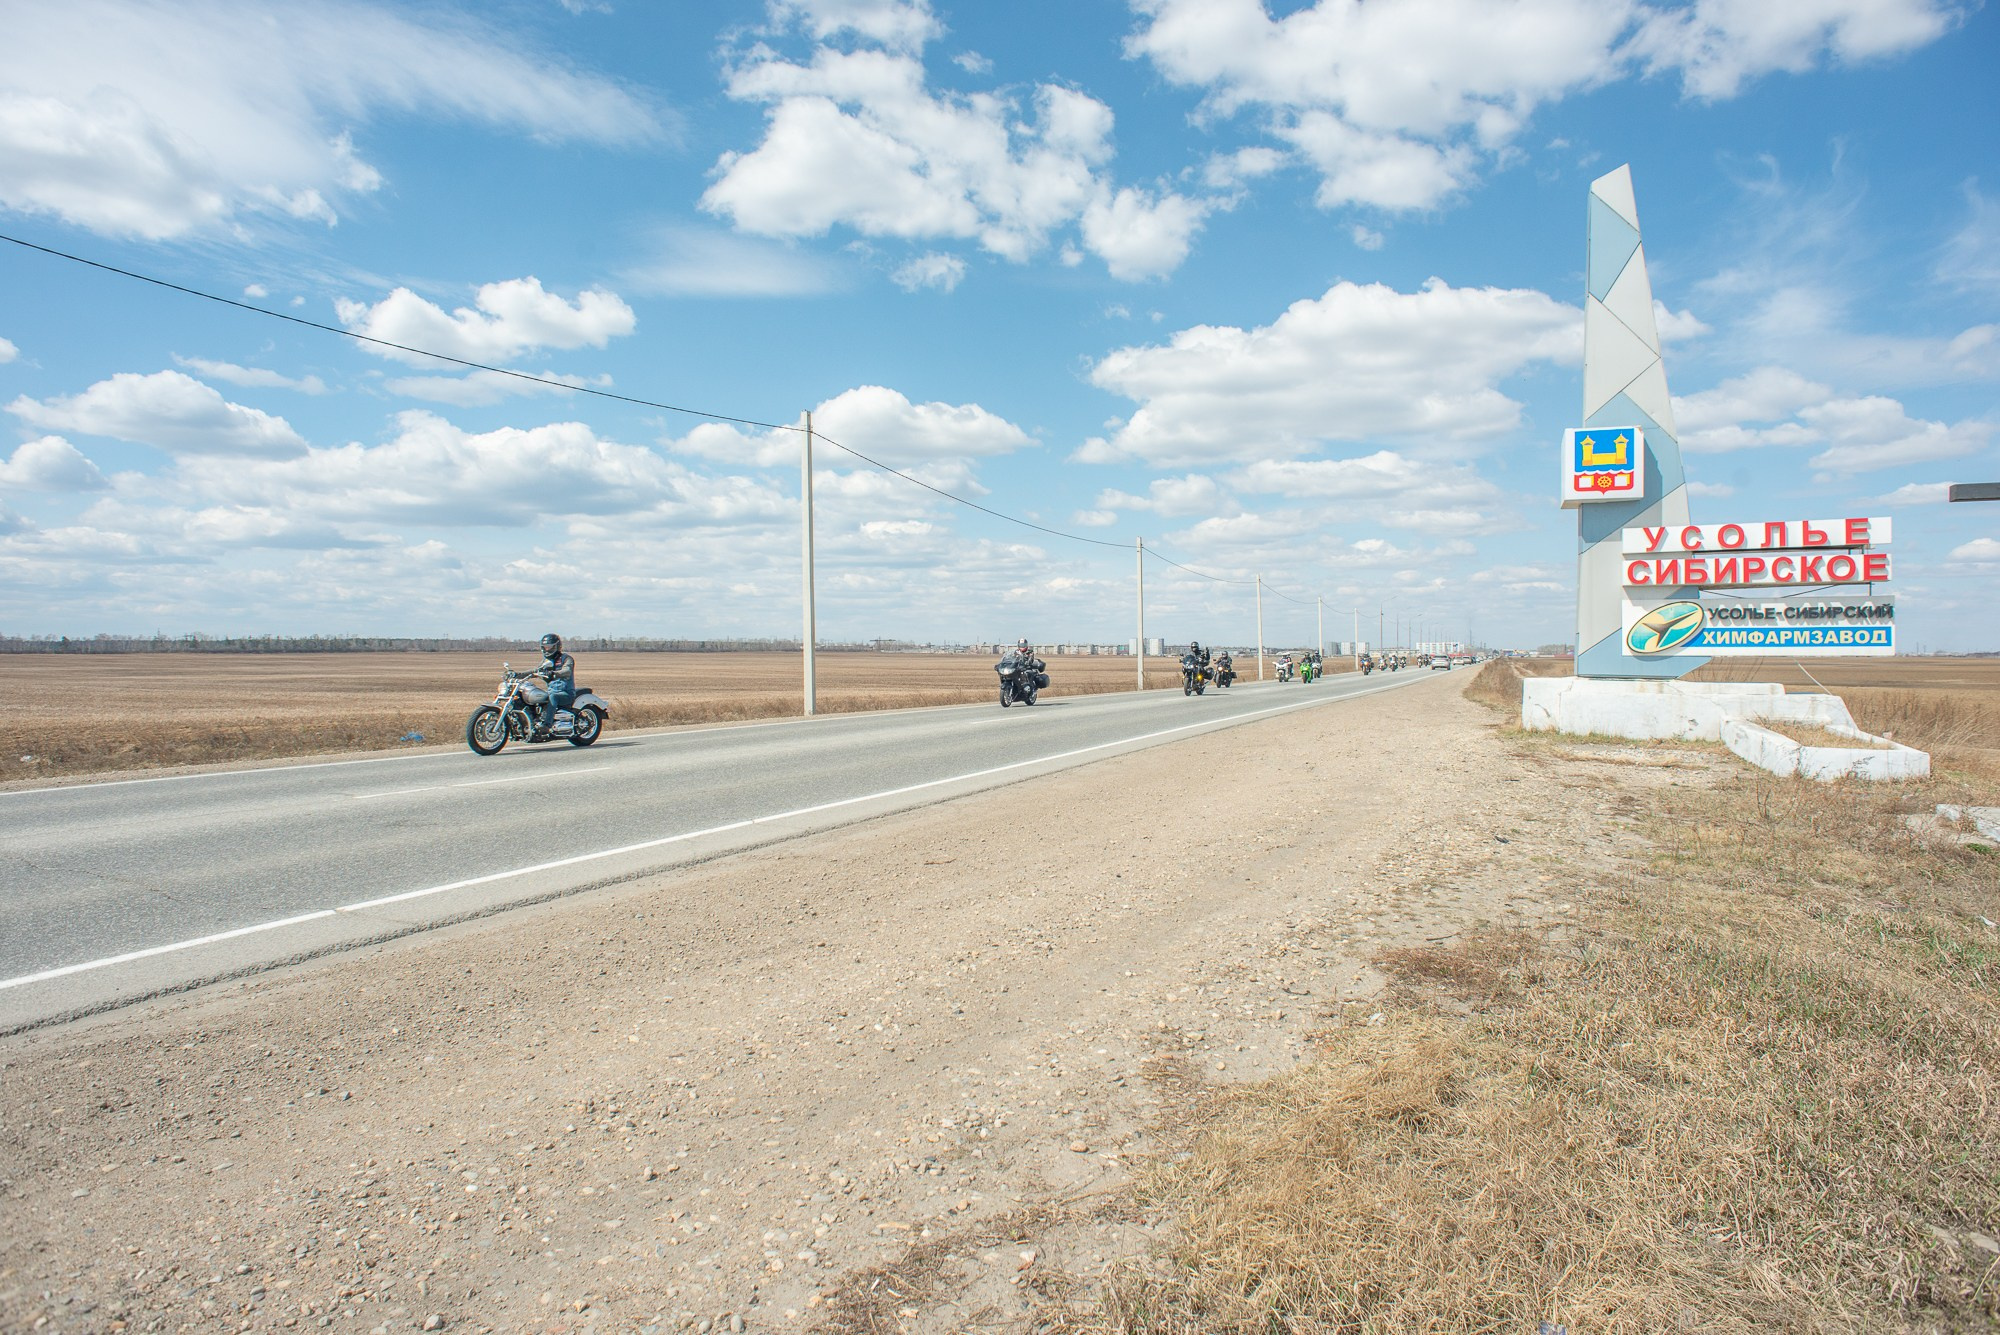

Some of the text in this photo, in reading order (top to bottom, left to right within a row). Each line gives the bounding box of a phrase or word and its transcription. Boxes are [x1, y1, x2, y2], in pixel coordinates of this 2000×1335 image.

[1643, 517, 1870, 551] УСОЛЬЕ
[1627, 553, 1888, 585] СИБИРСКОЕ
[1708, 603, 1894, 621] УСОЛЬЕ-СИБИРСКИЙ
[1702, 629, 1888, 646] ХИМФАРМЗАВОД
